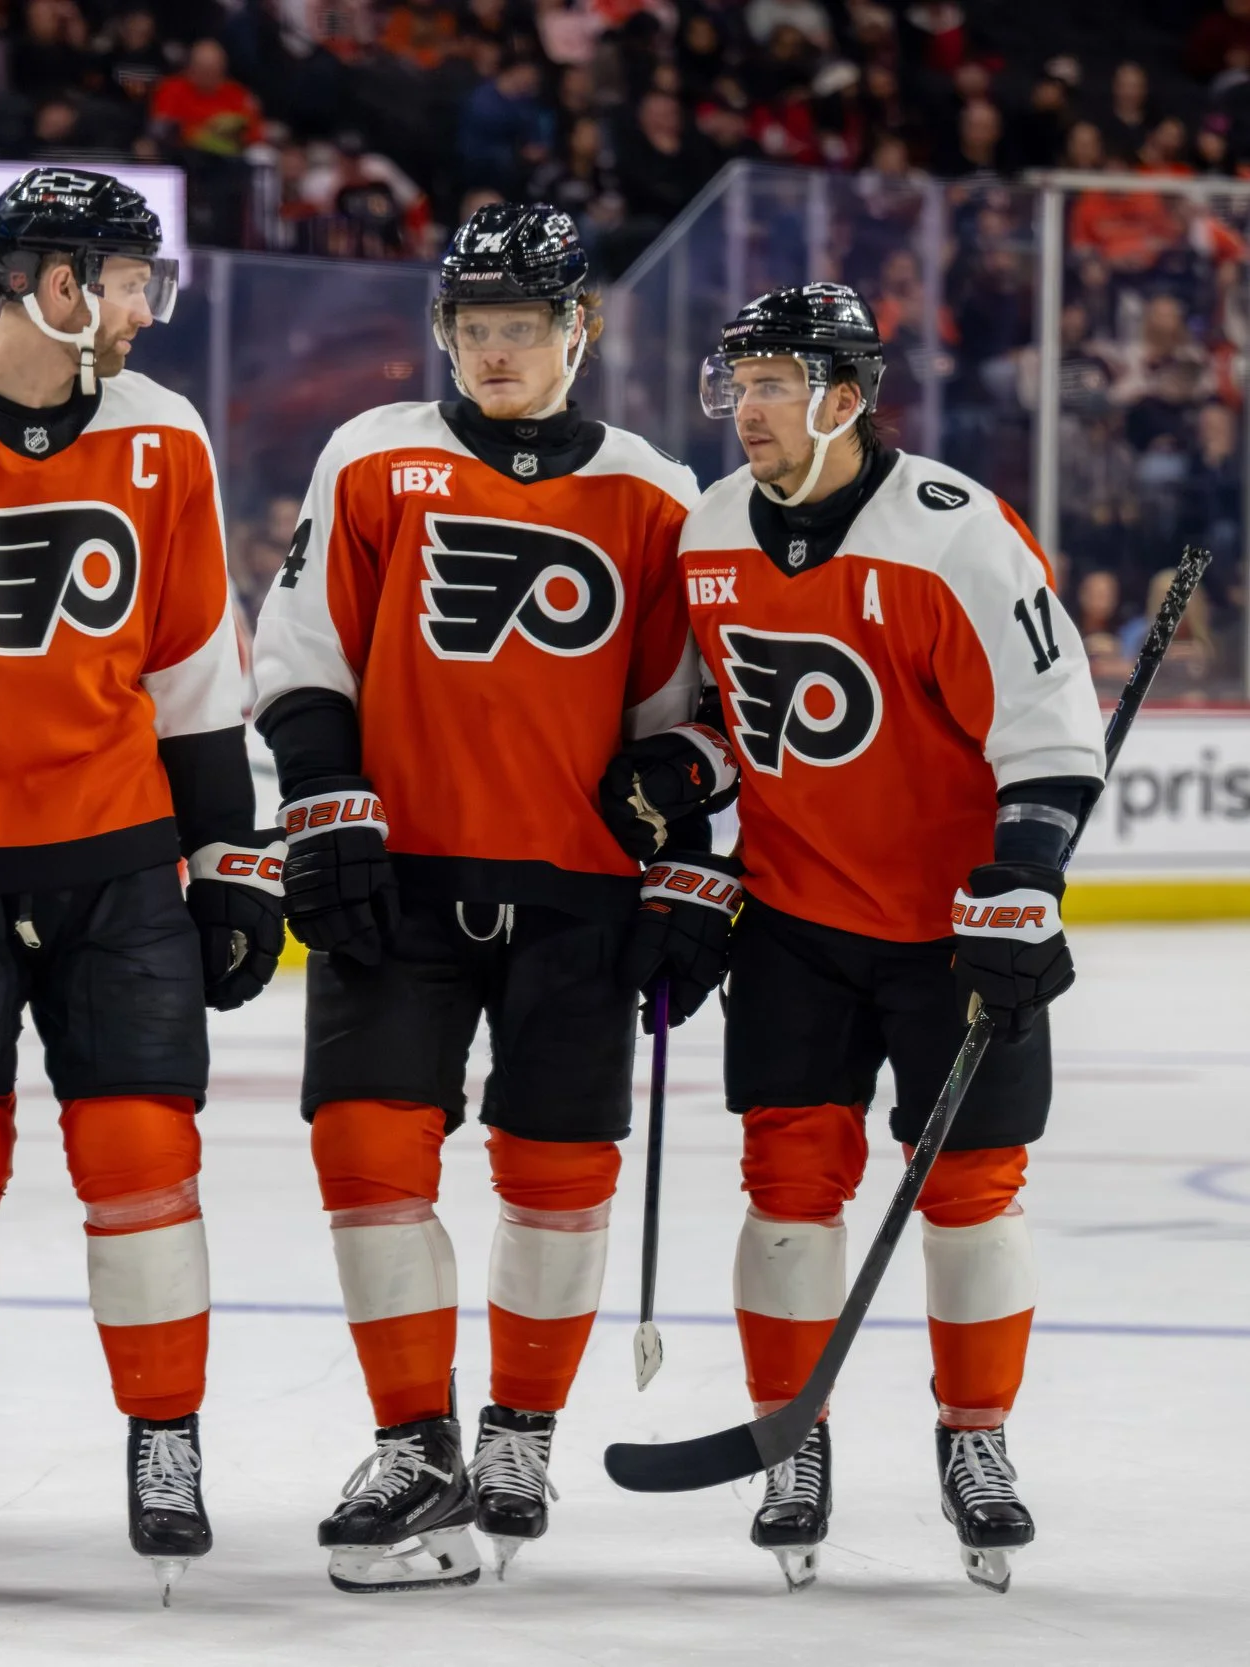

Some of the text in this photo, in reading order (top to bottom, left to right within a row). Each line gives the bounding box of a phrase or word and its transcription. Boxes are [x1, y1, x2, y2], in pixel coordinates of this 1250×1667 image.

[474, 232, 504, 253] 74
[460, 271, 503, 281] BAUER
[131, 433, 161, 489] C
[391, 459, 444, 469] Independence
[391, 467, 452, 496] IBX
[687, 576, 739, 605] IBX
[862, 568, 884, 625] A
[1014, 586, 1061, 675] 11
[1095, 747, 1250, 843] pris
[406, 1492, 440, 1525] BAUER
